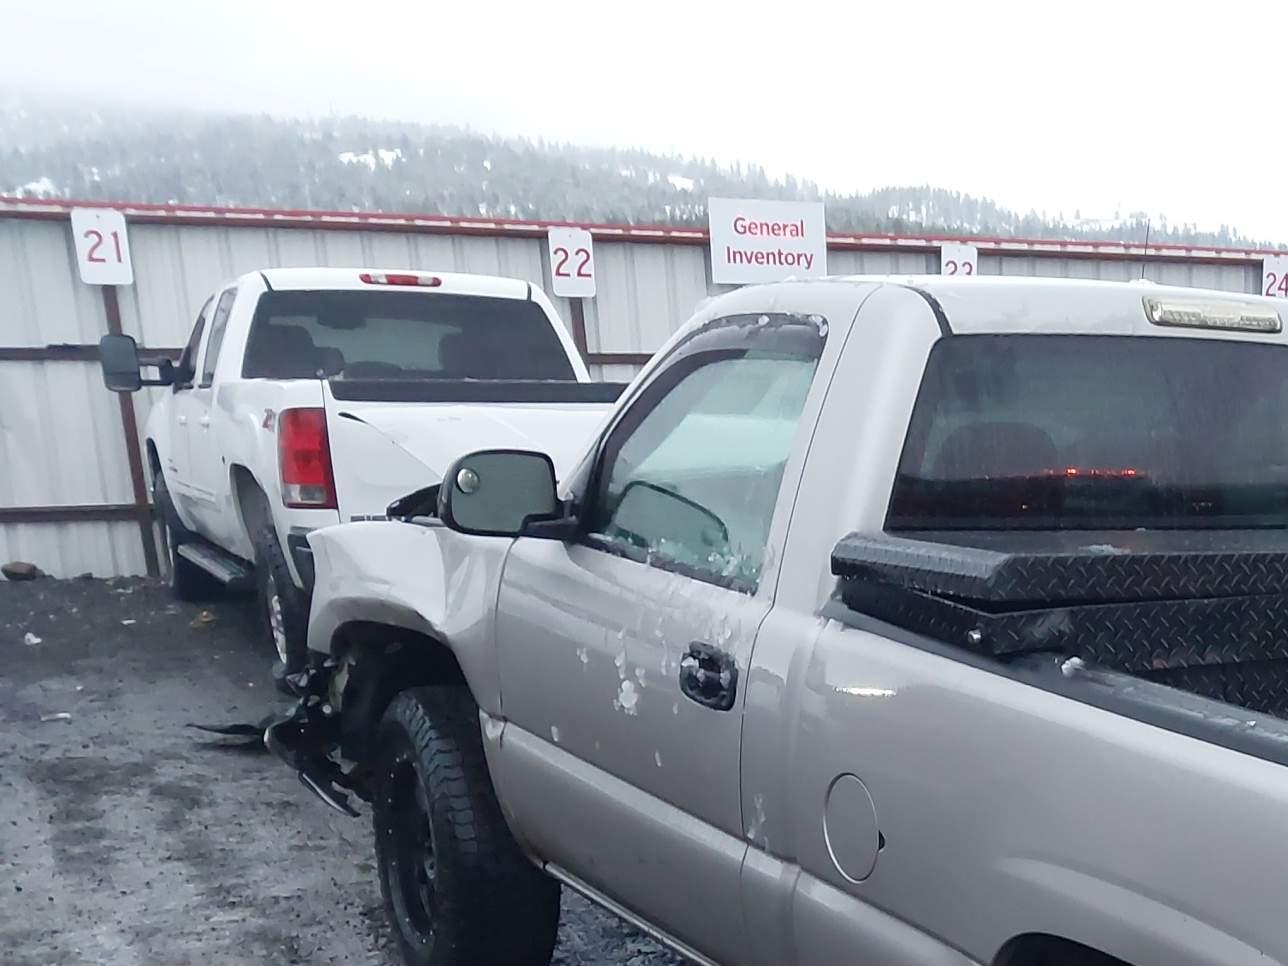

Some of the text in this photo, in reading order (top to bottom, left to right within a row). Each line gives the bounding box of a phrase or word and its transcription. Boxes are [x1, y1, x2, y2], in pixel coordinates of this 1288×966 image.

[733, 216, 804, 237] General
[83, 229, 122, 263] 21
[726, 245, 814, 270] Inventory
[553, 247, 592, 277] 22
